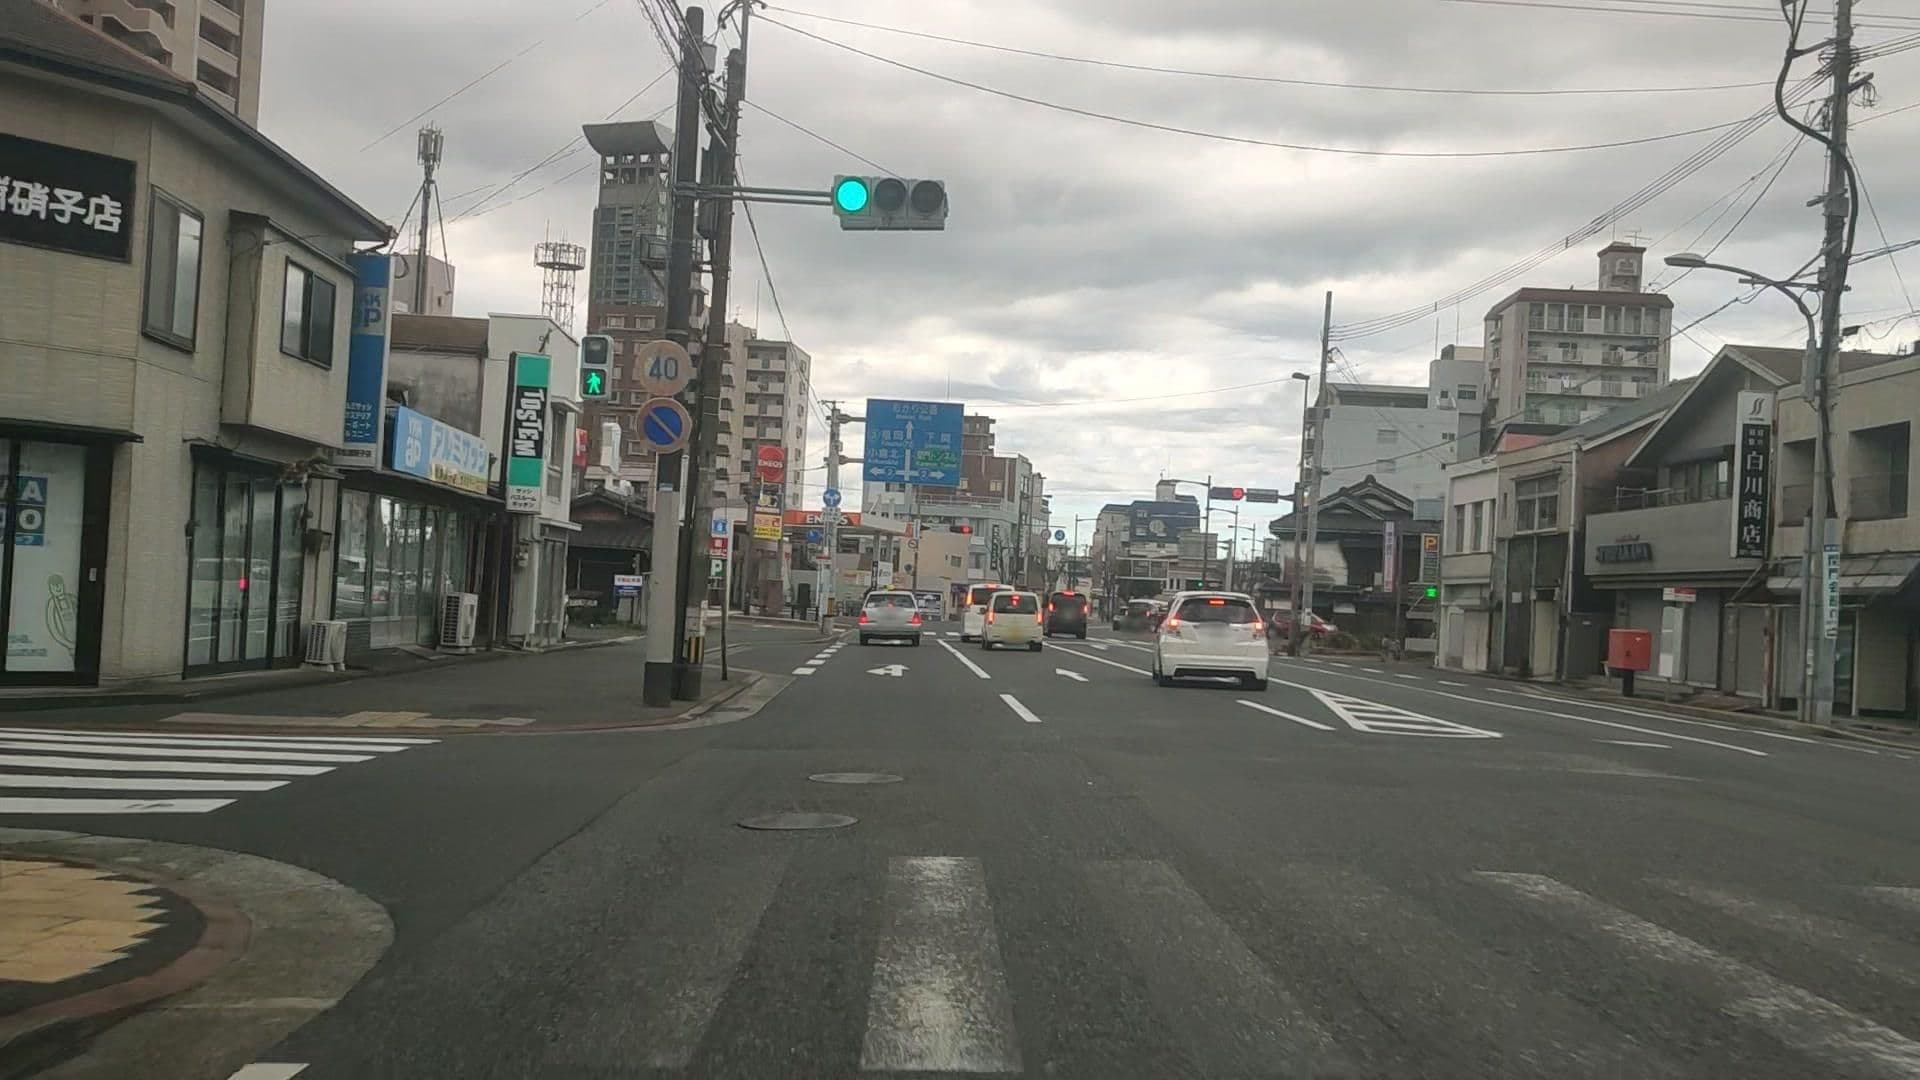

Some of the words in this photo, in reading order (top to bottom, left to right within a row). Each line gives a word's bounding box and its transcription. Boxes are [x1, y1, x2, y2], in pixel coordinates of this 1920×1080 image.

[0, 176, 122, 232] 硝子店
[649, 356, 679, 380] 40
[514, 389, 545, 457] TOSTEM
[758, 459, 783, 469] ENEOS
[1744, 450, 1764, 544] 白川商店
[806, 514, 849, 526] ENS
[711, 559, 723, 577] P
